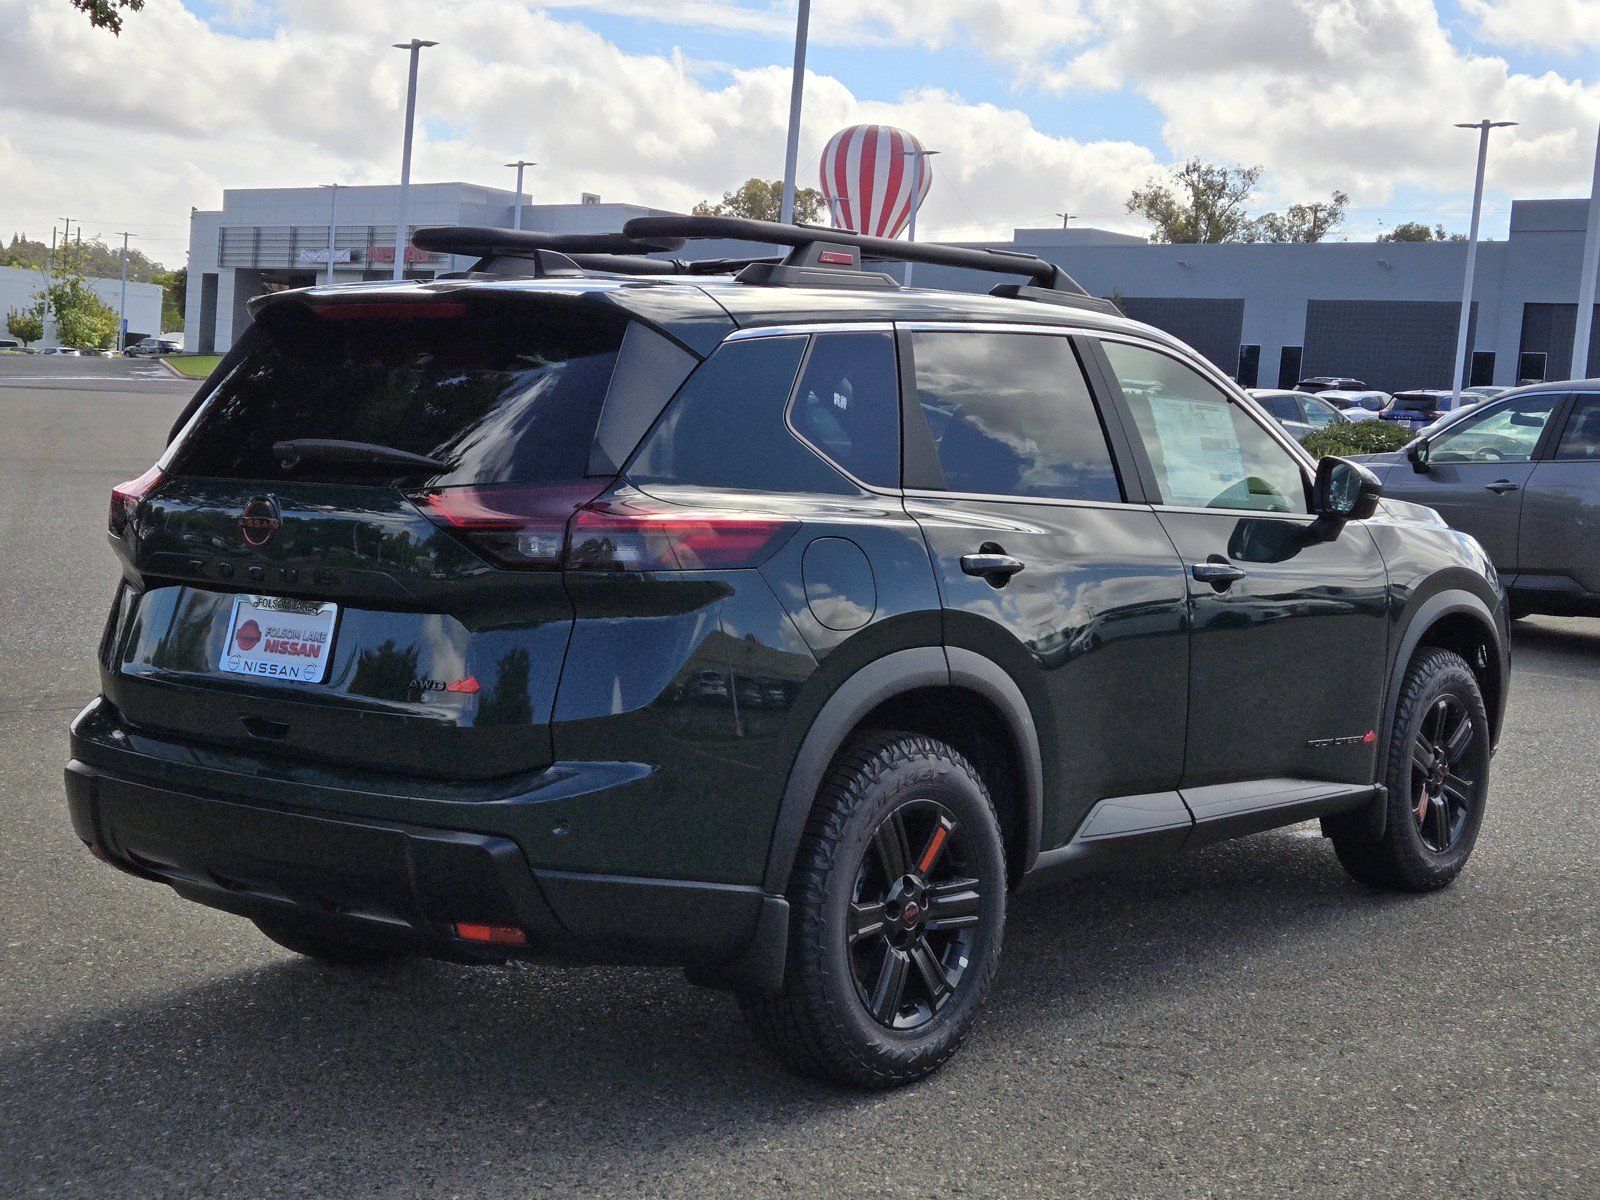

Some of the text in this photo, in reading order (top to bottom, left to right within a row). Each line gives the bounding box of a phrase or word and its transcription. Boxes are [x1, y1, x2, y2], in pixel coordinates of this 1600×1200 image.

[368, 247, 429, 263] NISAN
[257, 597, 290, 610] FOLSOM
[265, 626, 302, 640] FOLSOM
[302, 630, 328, 643] LAKE
[264, 639, 321, 658] NISSAN
[242, 661, 299, 678] NISSAN
[408, 680, 447, 692] AWD
